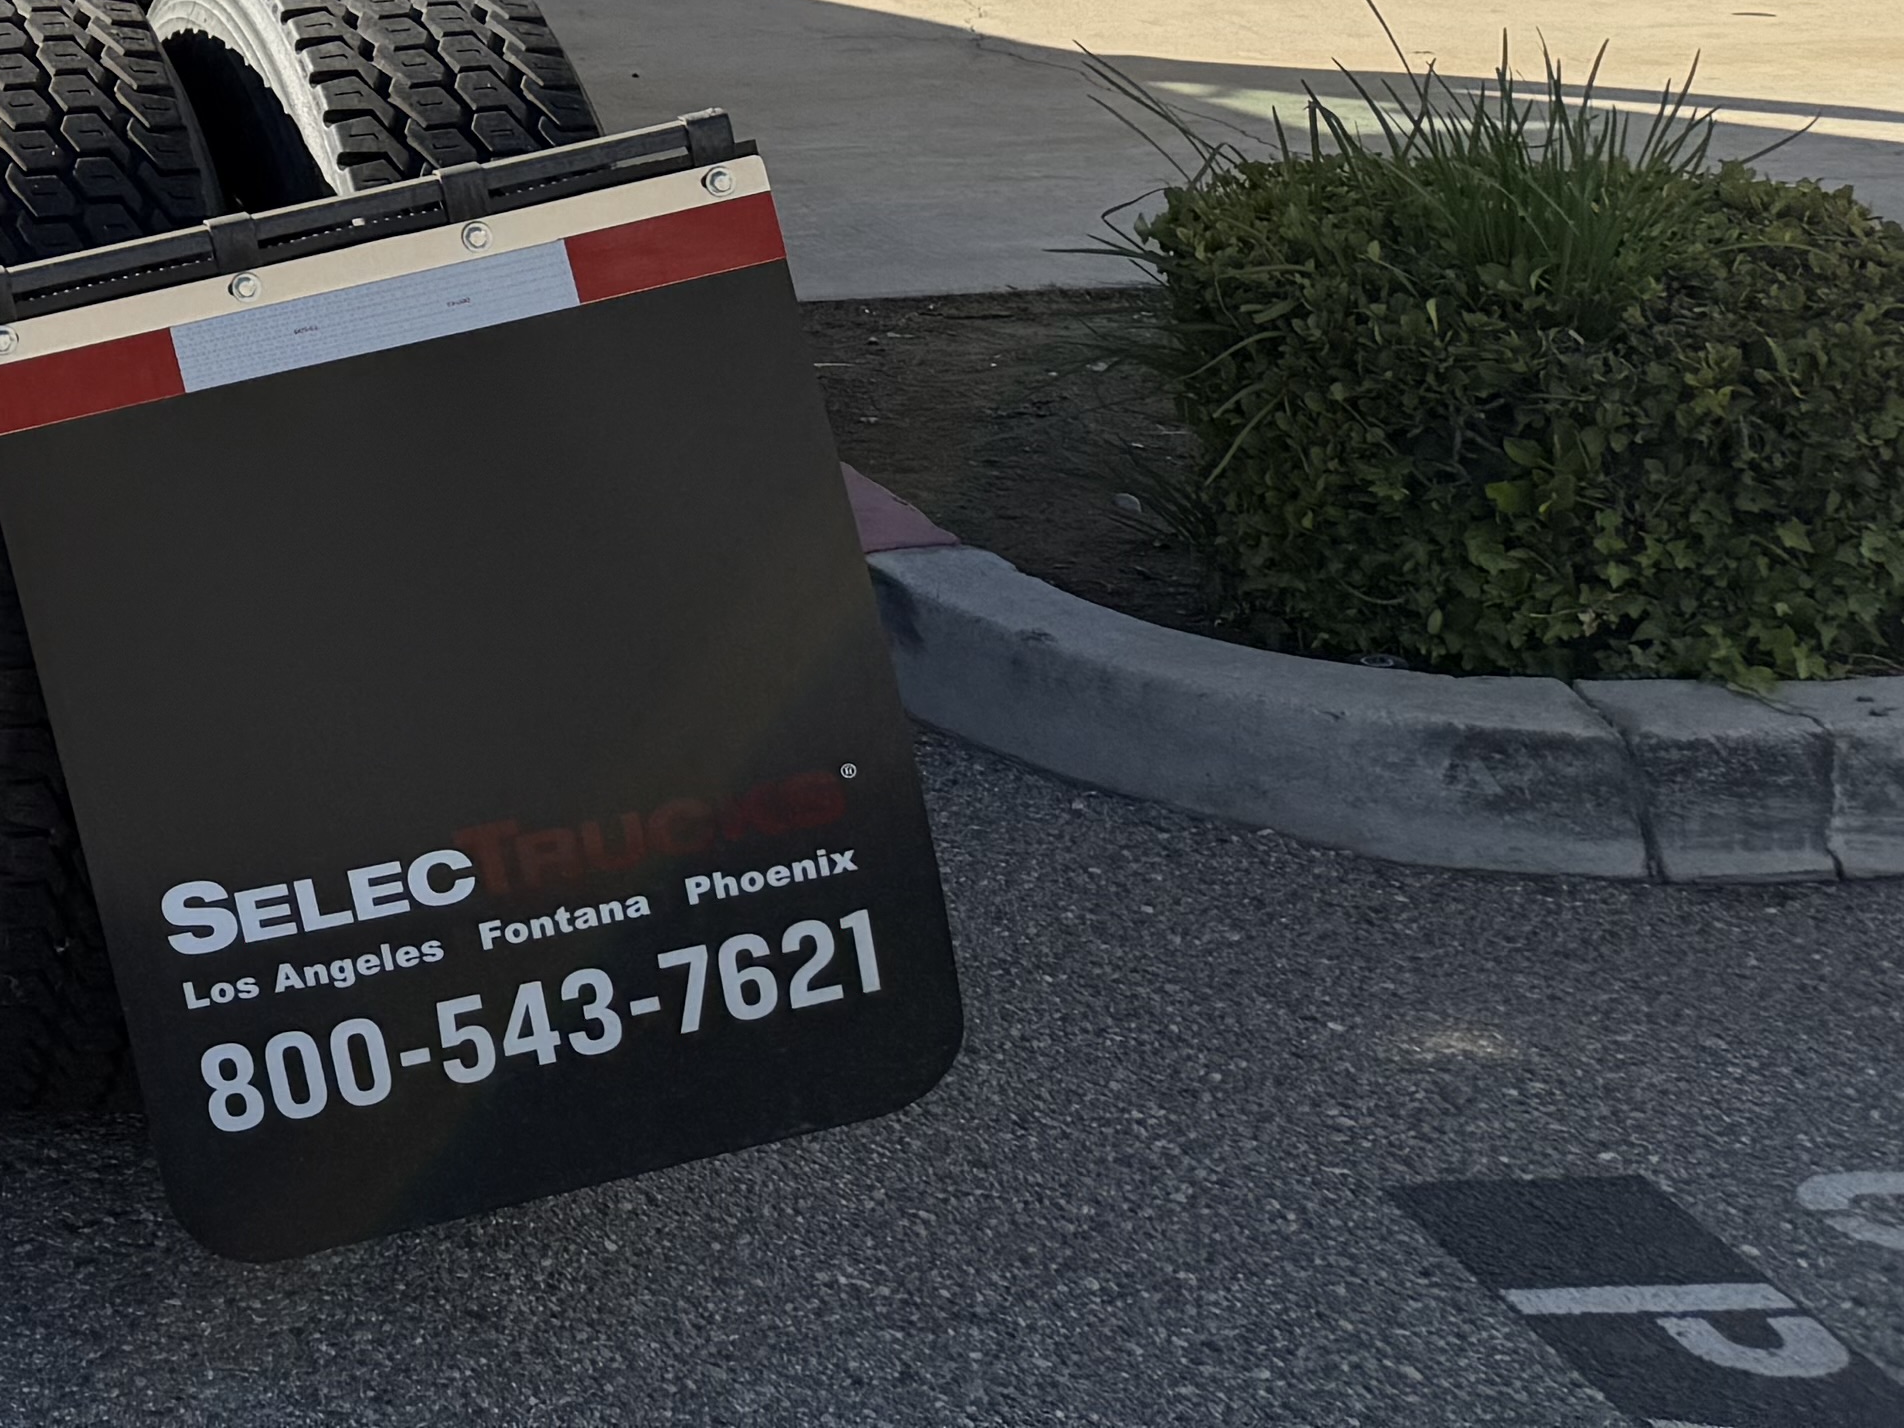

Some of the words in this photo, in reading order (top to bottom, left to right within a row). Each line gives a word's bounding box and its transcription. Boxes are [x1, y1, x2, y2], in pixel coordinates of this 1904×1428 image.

[182, 976, 260, 1011] Los
[274, 934, 445, 993] Angeles
[479, 892, 651, 951] Fontana
[682, 845, 859, 907] Phoenix
[199, 907, 882, 1133] 800-543-7621
